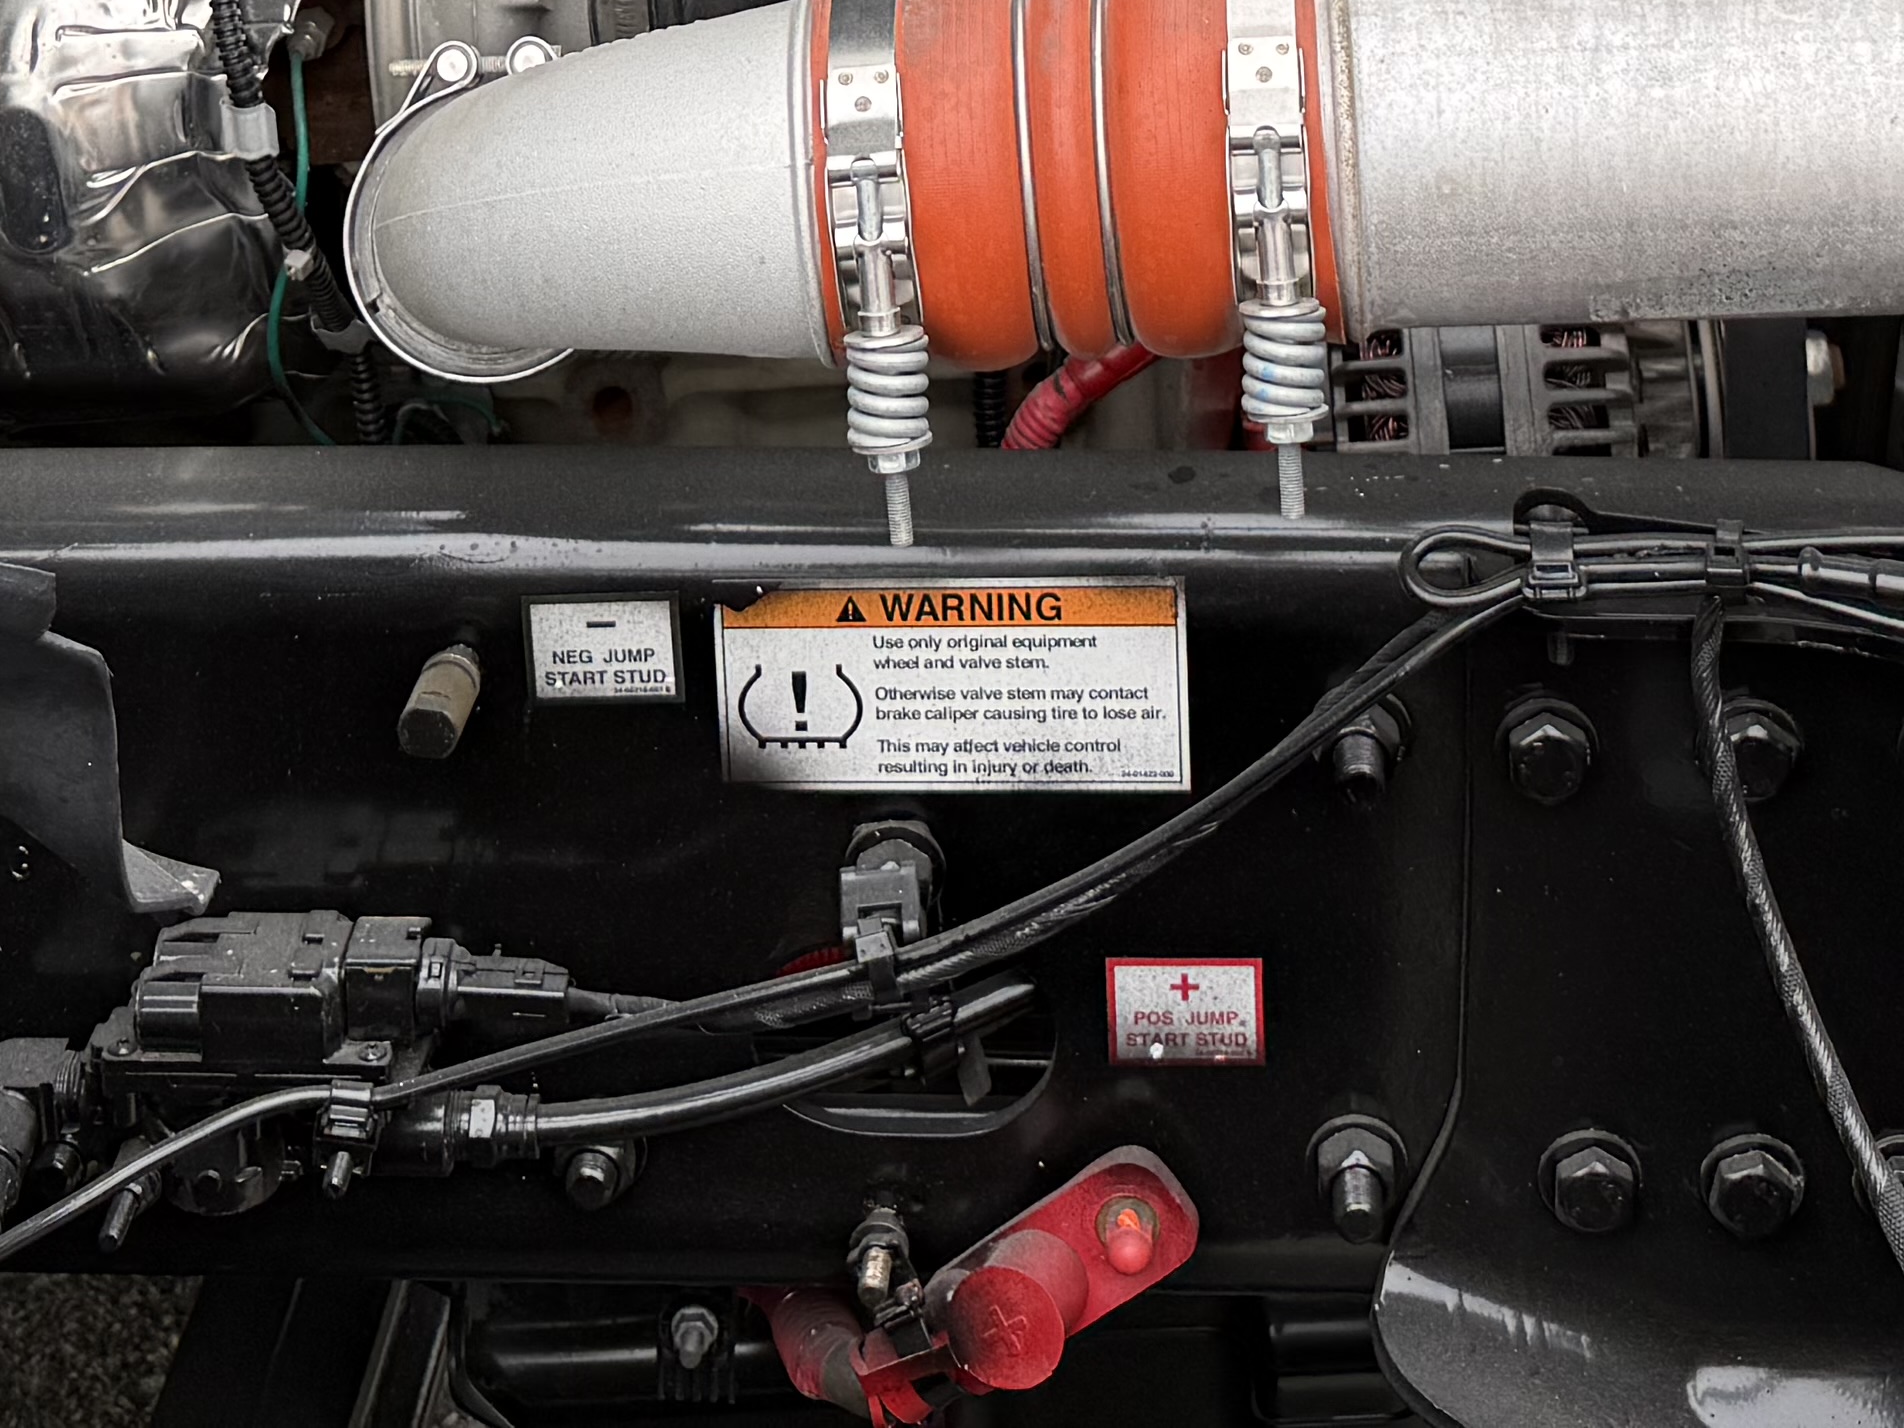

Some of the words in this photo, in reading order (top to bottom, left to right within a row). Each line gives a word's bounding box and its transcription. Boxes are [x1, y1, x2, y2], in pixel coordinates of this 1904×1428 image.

[881, 593, 1063, 622] WARNING
[873, 635, 904, 650] Use
[908, 634, 943, 653] only
[947, 634, 1007, 653] original
[1012, 634, 1097, 653] equipment
[552, 649, 593, 664] NEG
[603, 648, 655, 663] JUMP
[874, 655, 919, 670] wheel
[923, 655, 955, 670] and
[960, 655, 1002, 670] valve
[1007, 656, 1050, 670] stem.
[545, 670, 607, 687] START
[613, 669, 667, 684] STUD
[875, 686, 956, 701] Otherwise
[960, 686, 1002, 701] valve
[1007, 687, 1046, 701] stem
[1050, 689, 1084, 704] may
[1088, 686, 1149, 701] contact
[876, 706, 921, 721] brake
[925, 705, 979, 724] caliper
[982, 706, 1046, 725] causing
[1050, 706, 1078, 721] tire
[1082, 707, 1098, 721] to
[1102, 706, 1137, 721] lose
[1141, 706, 1167, 721] air.
[878, 738, 909, 754] This
[913, 741, 947, 757] may
[952, 738, 999, 755] affect
[1003, 738, 1060, 754] vehicle
[1064, 738, 1121, 754] control
[878, 758, 949, 778] resulting
[953, 758, 967, 774] in
[972, 758, 1017, 779] injury
[1021, 762, 1038, 774] or
[1044, 758, 1093, 774] death.
[1134, 1011, 1174, 1025] POS
[1185, 1010, 1238, 1025] JUMP
[1126, 1032, 1189, 1047] START
[1196, 1032, 1247, 1047] STUD
